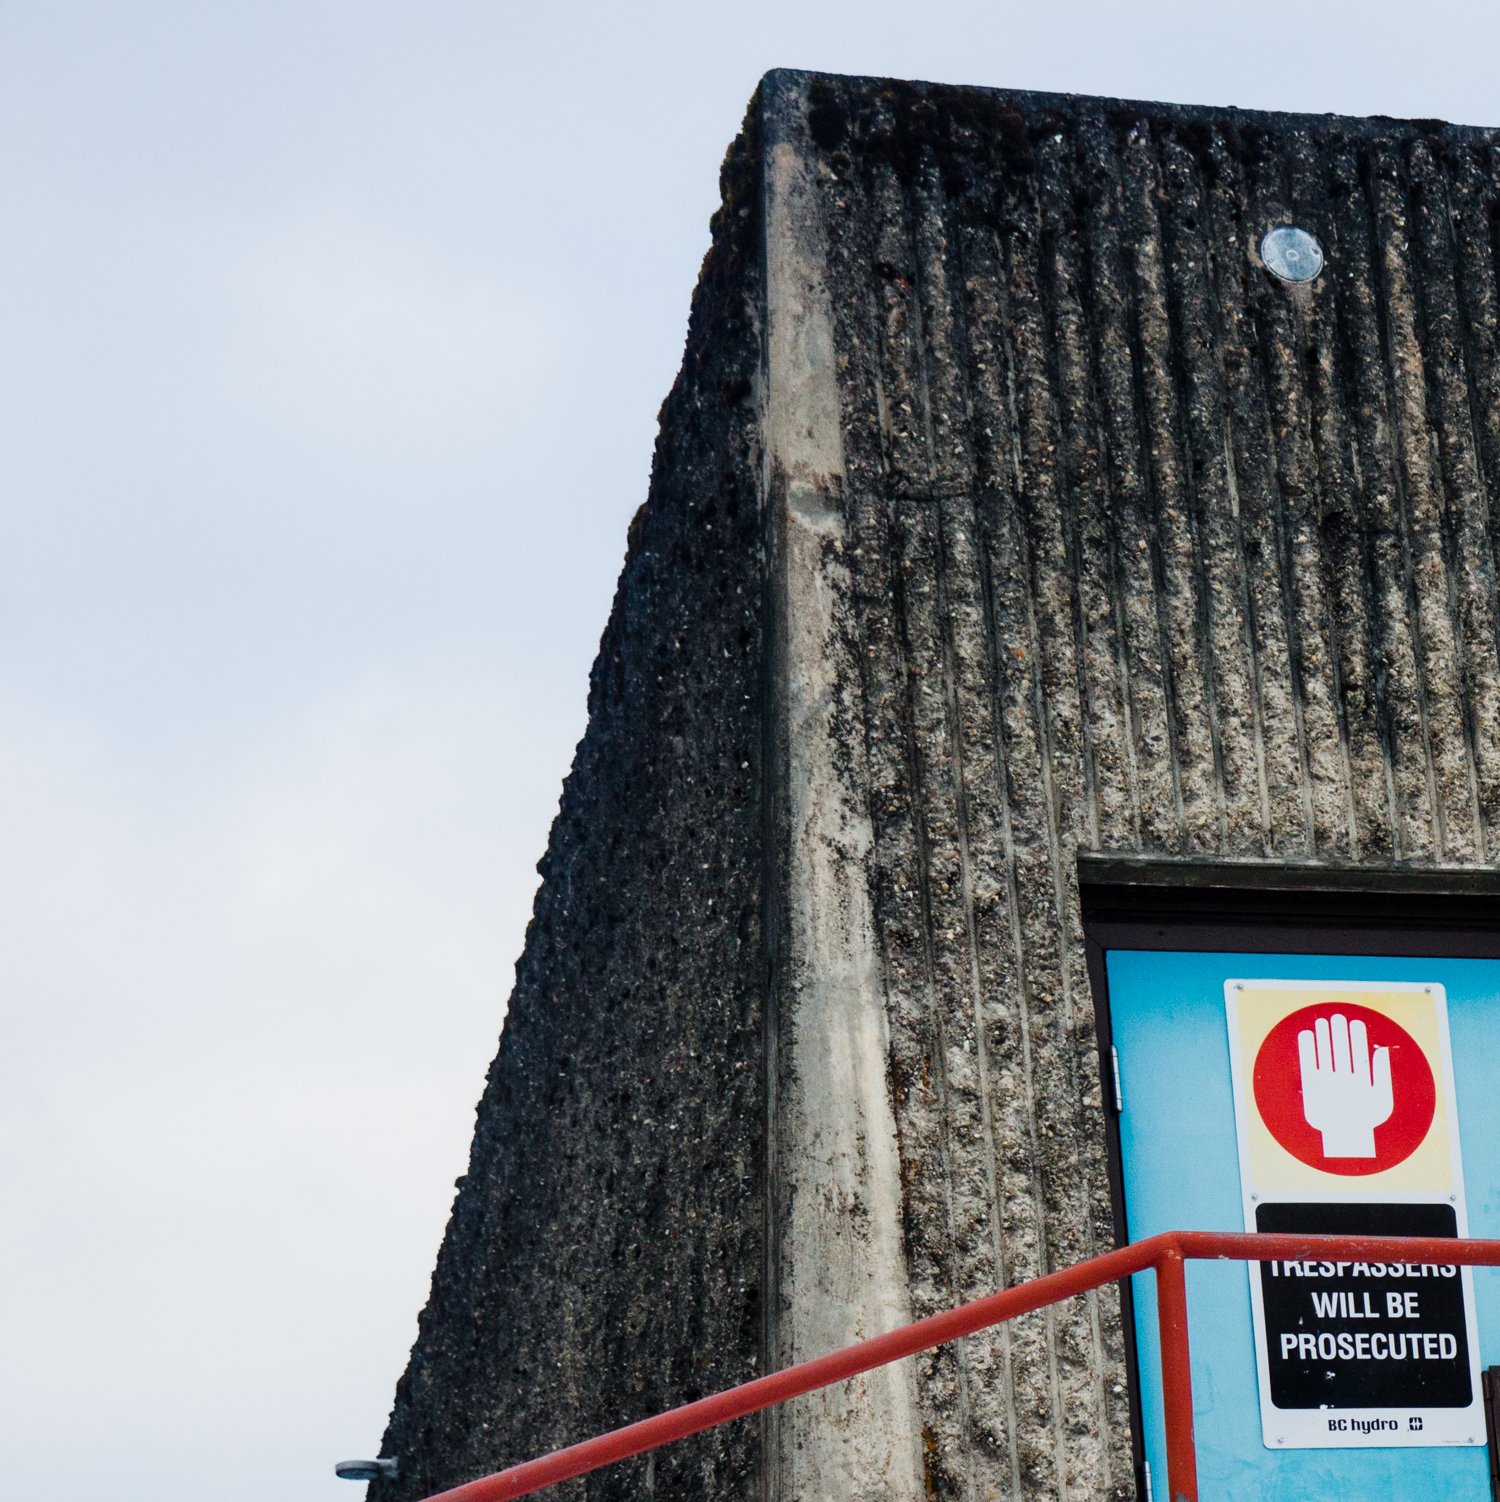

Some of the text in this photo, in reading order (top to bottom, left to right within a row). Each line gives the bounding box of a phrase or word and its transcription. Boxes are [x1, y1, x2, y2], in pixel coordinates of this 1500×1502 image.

[1311, 1292, 1420, 1318] WILL BE
[1280, 1333, 1458, 1360] PROSECUTED
[1328, 1418, 1399, 1434] BC hydro
